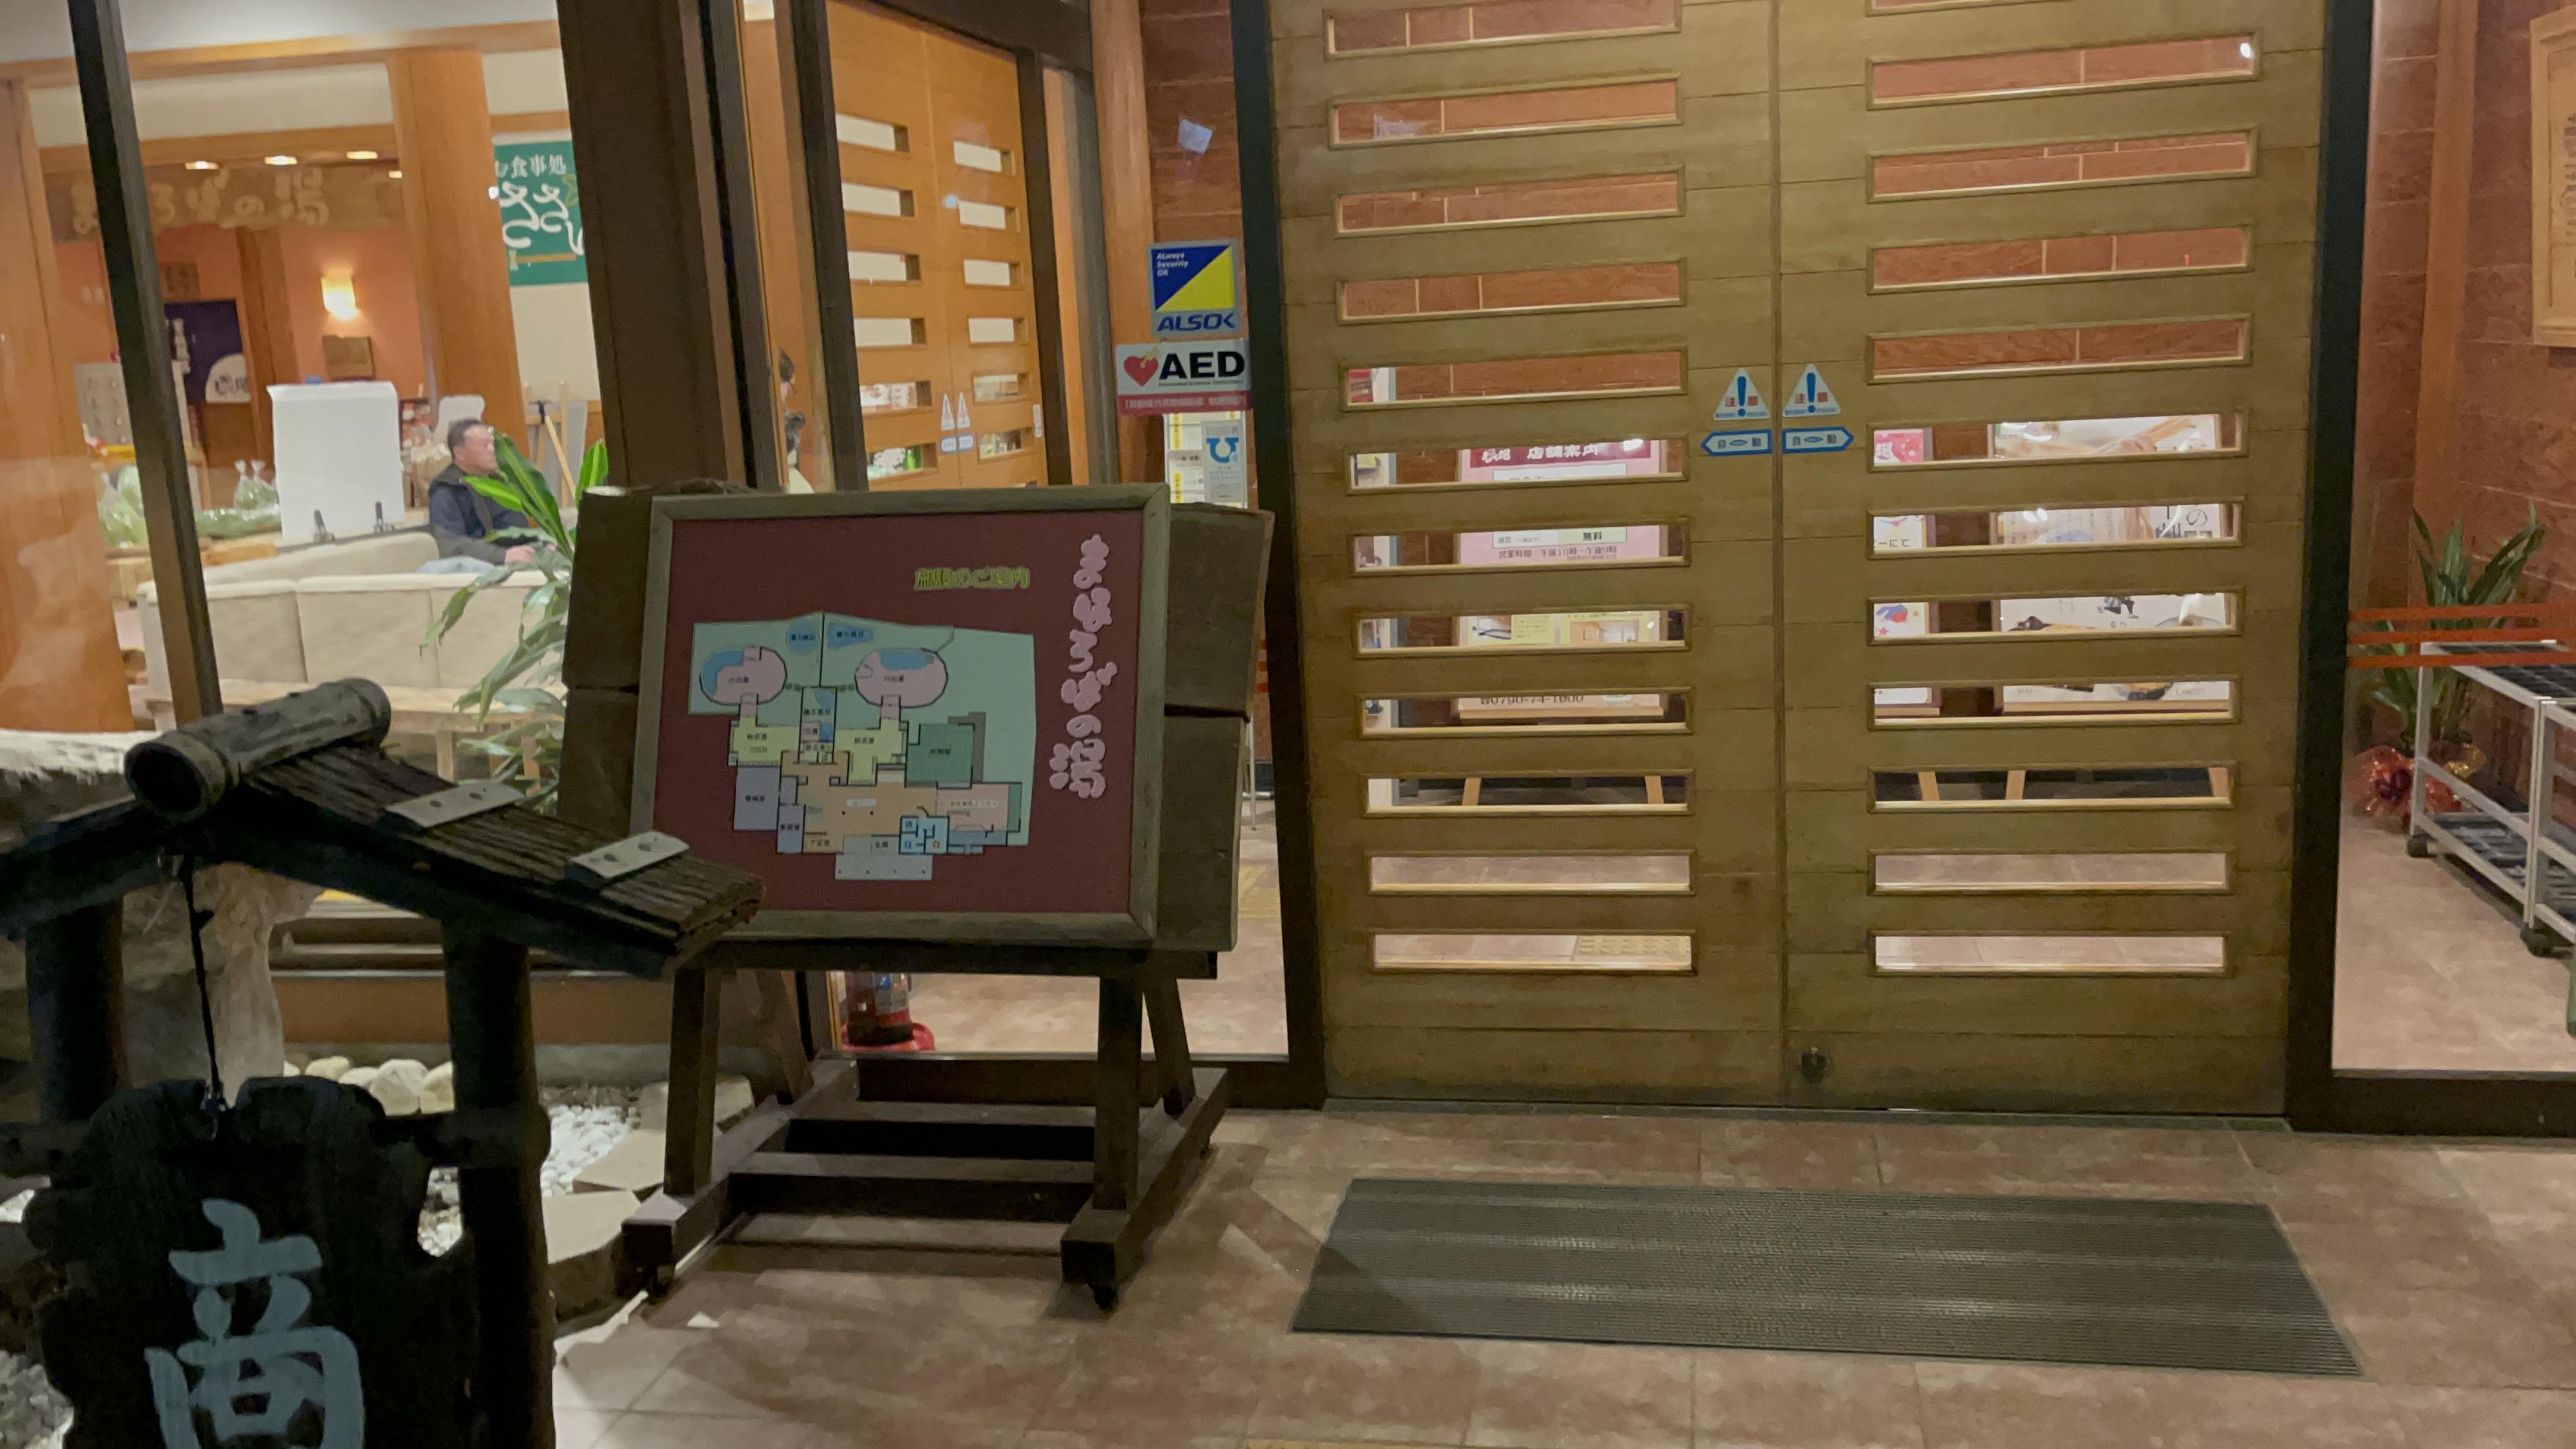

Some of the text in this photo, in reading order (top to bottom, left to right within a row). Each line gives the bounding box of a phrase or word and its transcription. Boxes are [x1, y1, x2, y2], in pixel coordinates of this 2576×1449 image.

[1157, 312, 1235, 332] ALSOK
[1158, 351, 1245, 380] AED
[1873, 538, 1910, 548] ーにて
